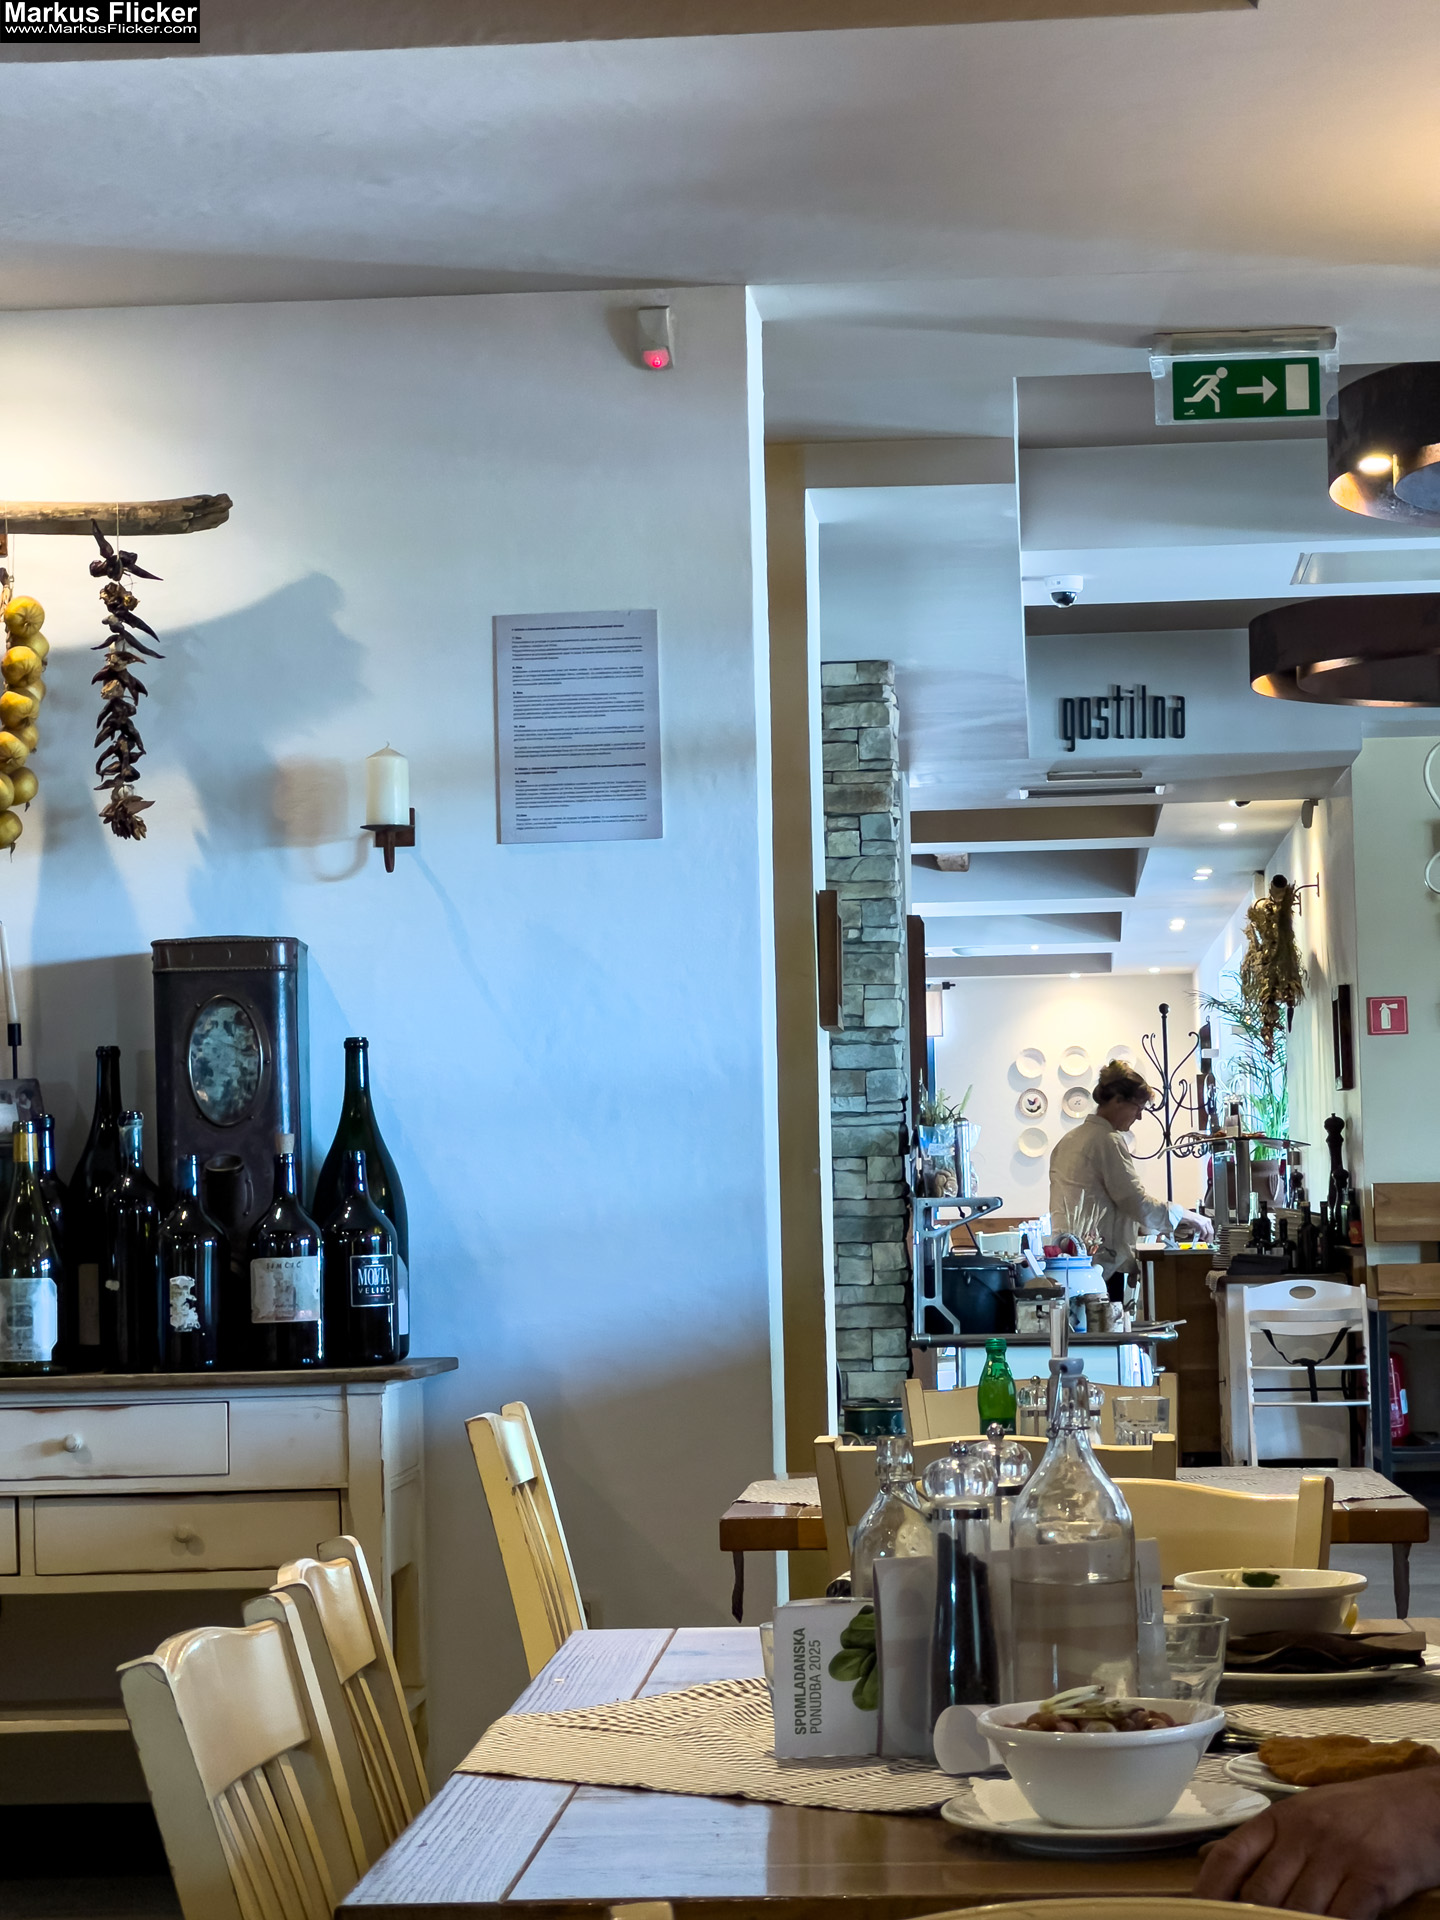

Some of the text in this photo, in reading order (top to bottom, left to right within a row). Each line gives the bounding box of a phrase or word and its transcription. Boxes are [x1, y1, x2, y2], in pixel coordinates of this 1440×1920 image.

[1061, 684, 1186, 752] gostilna
[357, 1267, 390, 1286] MOVIA
[357, 1286, 391, 1294] VELIKO
[793, 1627, 807, 1735] SPOMLADANSKA
[808, 1639, 822, 1734] PONUDBA 2025
